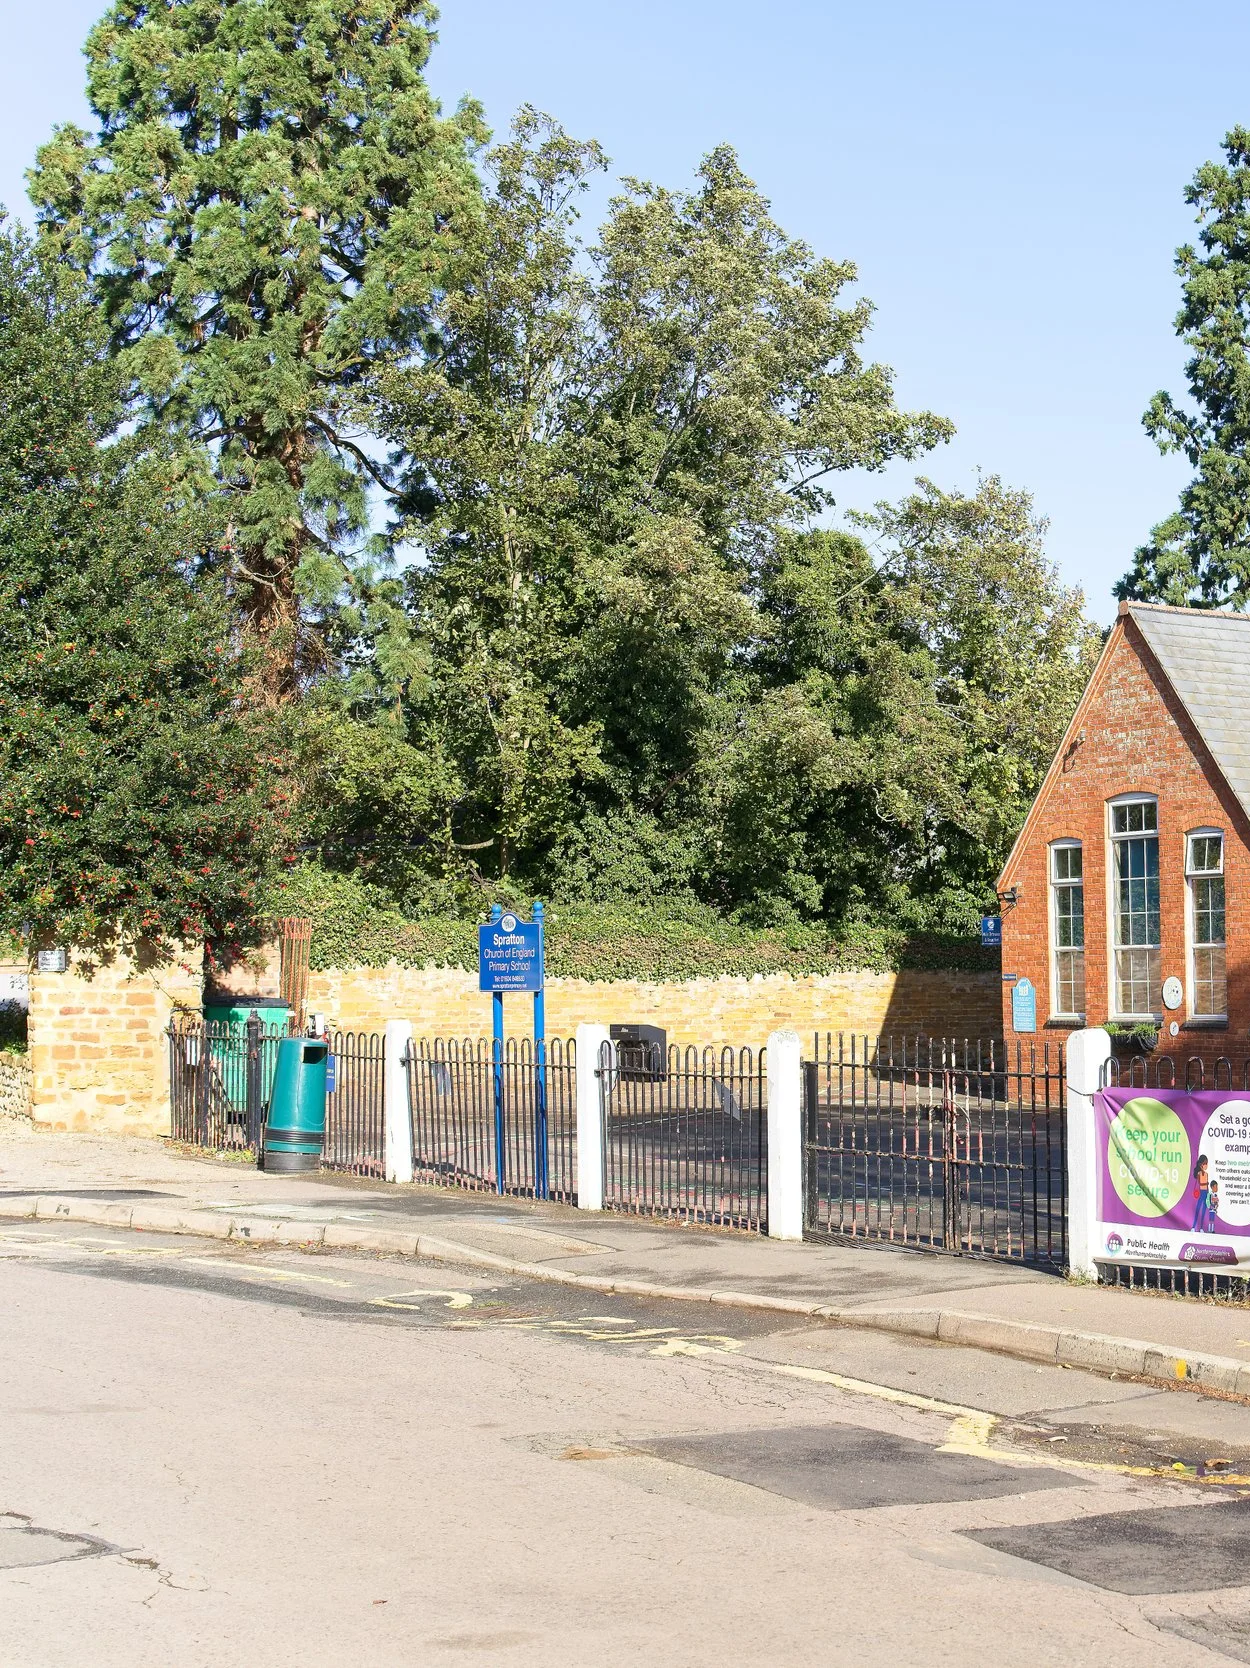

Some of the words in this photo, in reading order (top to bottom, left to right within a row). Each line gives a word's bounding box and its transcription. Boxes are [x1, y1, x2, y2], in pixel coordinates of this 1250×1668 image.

[493, 933, 525, 948] Spratton
[484, 948, 505, 959] Church
[504, 947, 511, 958] of
[511, 947, 535, 960] England
[488, 961, 510, 973] Primary
[510, 960, 531, 971] School
[1219, 1113, 1233, 1125] Set
[1234, 1117, 1241, 1125] a
[1116, 1126, 1149, 1145] Keep
[1152, 1131, 1181, 1145] your
[1207, 1127, 1247, 1140] COVID-19
[1161, 1151, 1182, 1163] run
[1225, 1190, 1244, 1198] covering
[1126, 1238, 1147, 1249] Public
[1148, 1240, 1170, 1252] Health
[1124, 1249, 1168, 1260] Northamptonshire
